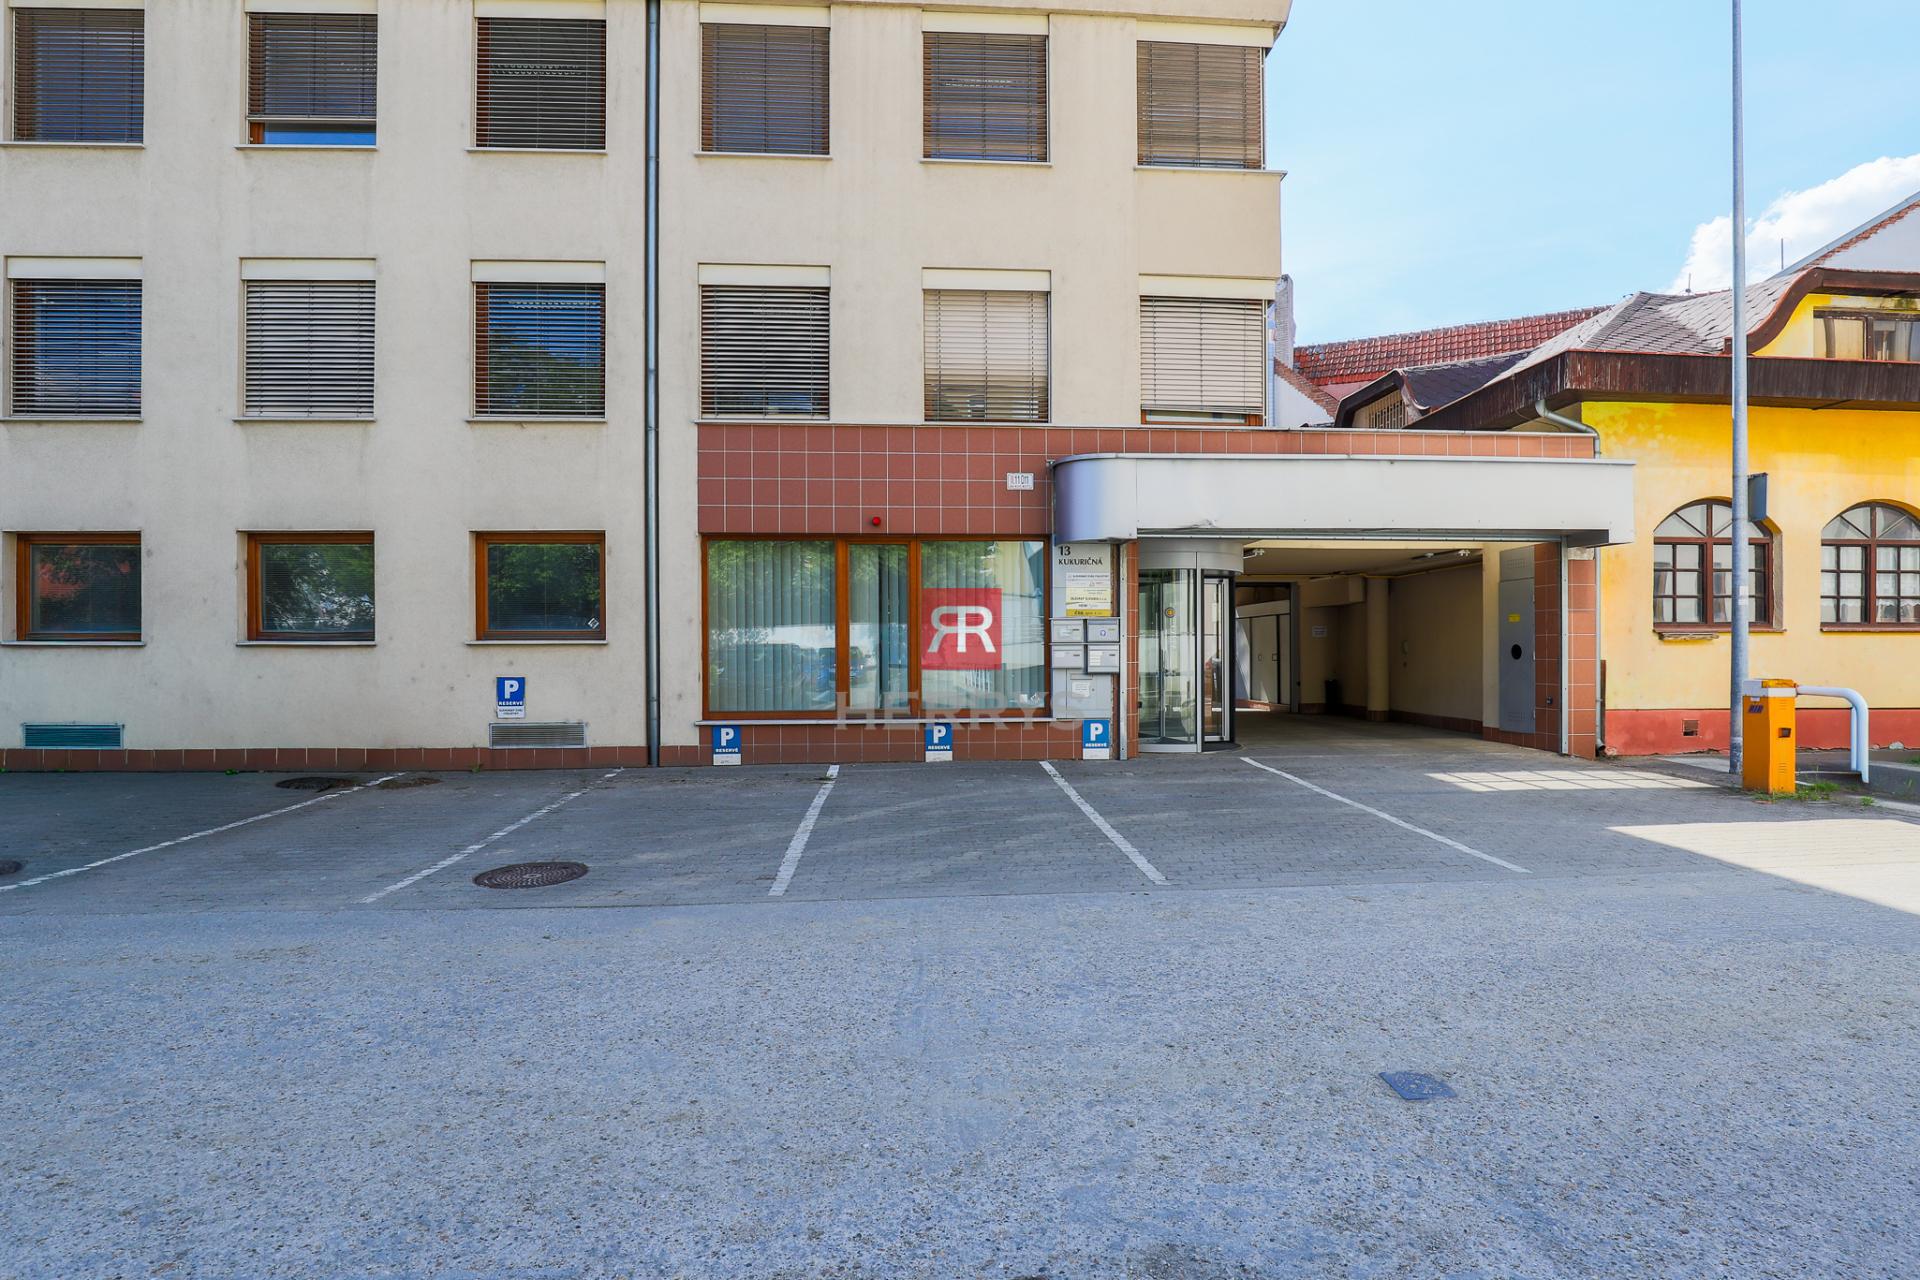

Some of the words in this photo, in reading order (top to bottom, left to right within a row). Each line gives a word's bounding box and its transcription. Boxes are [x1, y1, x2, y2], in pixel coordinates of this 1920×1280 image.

[1058, 545, 1071, 556] 13
[1058, 556, 1103, 566] KUKURIČNÁ
[504, 680, 519, 699] P
[720, 727, 735, 746] P
[933, 725, 947, 744] P
[1090, 722, 1103, 741] P
